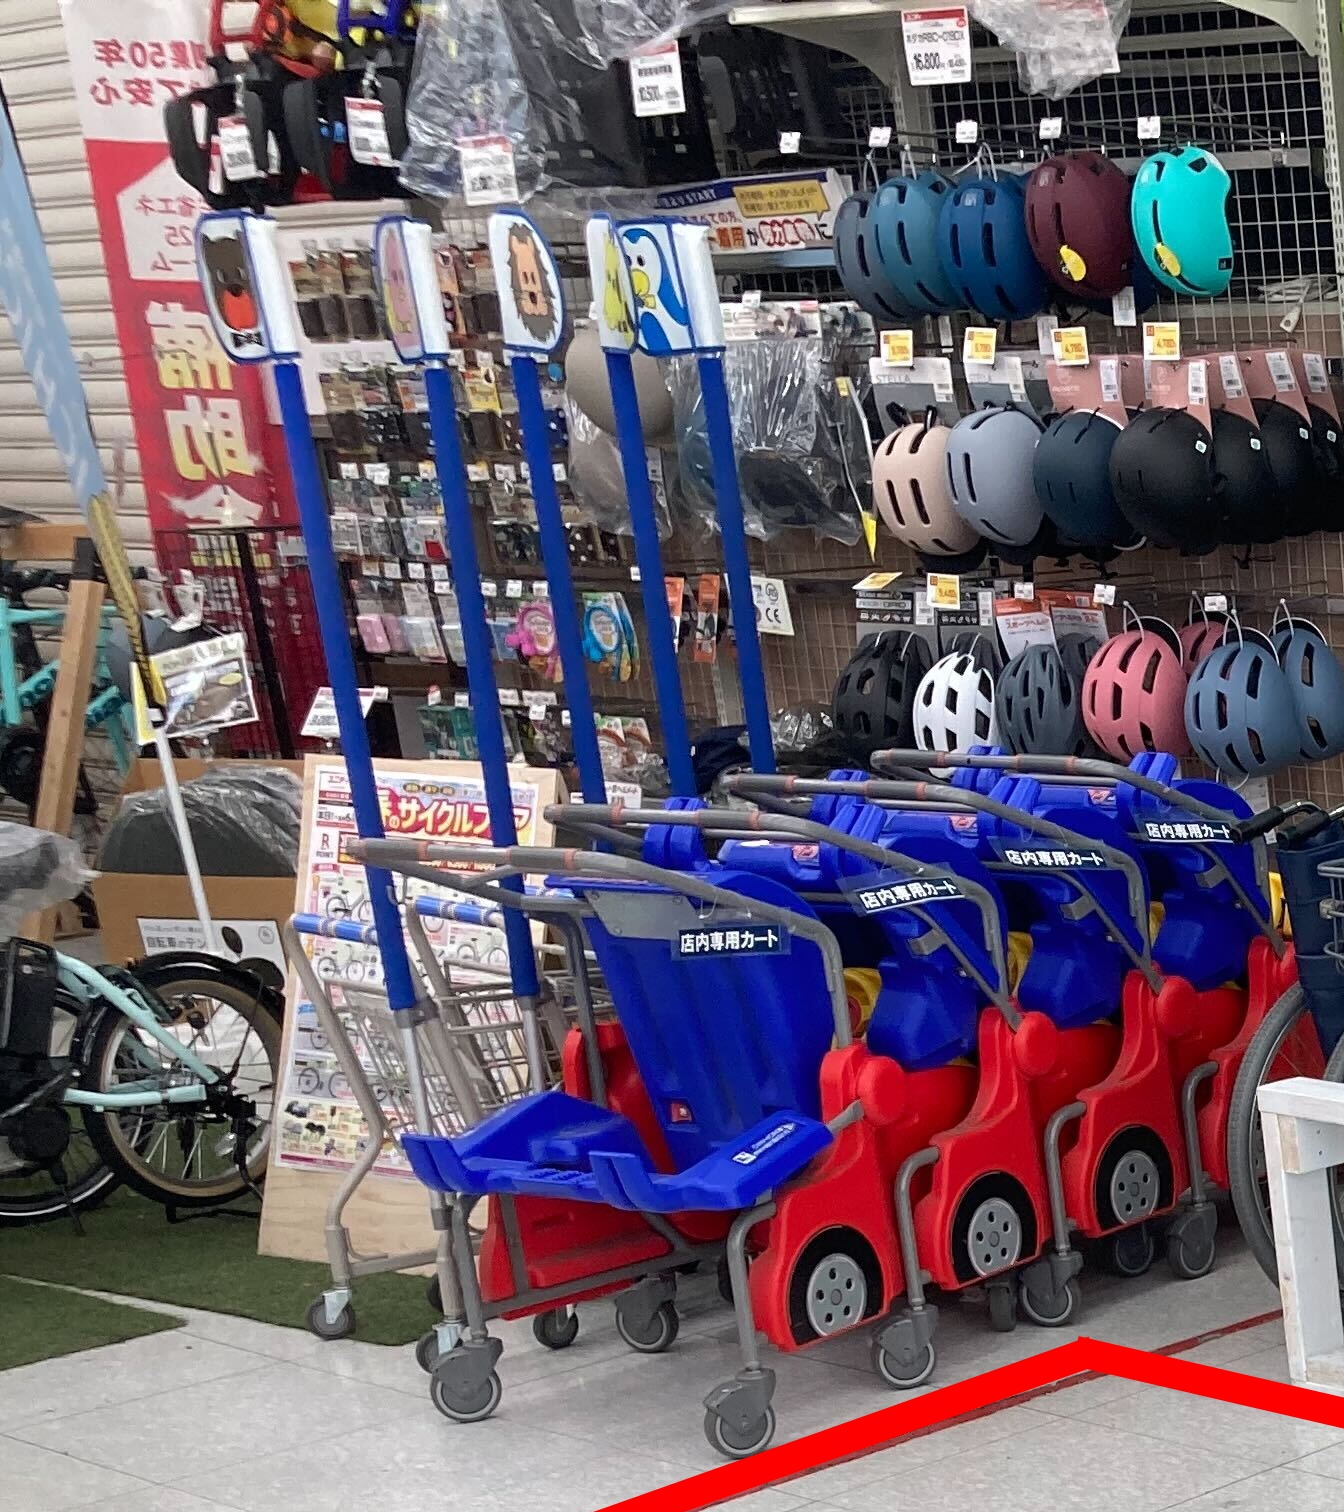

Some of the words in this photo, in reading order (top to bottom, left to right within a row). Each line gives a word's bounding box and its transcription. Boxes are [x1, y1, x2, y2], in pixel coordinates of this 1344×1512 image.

[377, 788, 531, 834] のサイクルフア
[1145, 823, 1231, 839] 店内専用カート
[1005, 850, 1104, 866] 店内専用カート
[859, 880, 957, 909] 店内専用カート
[680, 929, 778, 953] 店内専用カート
